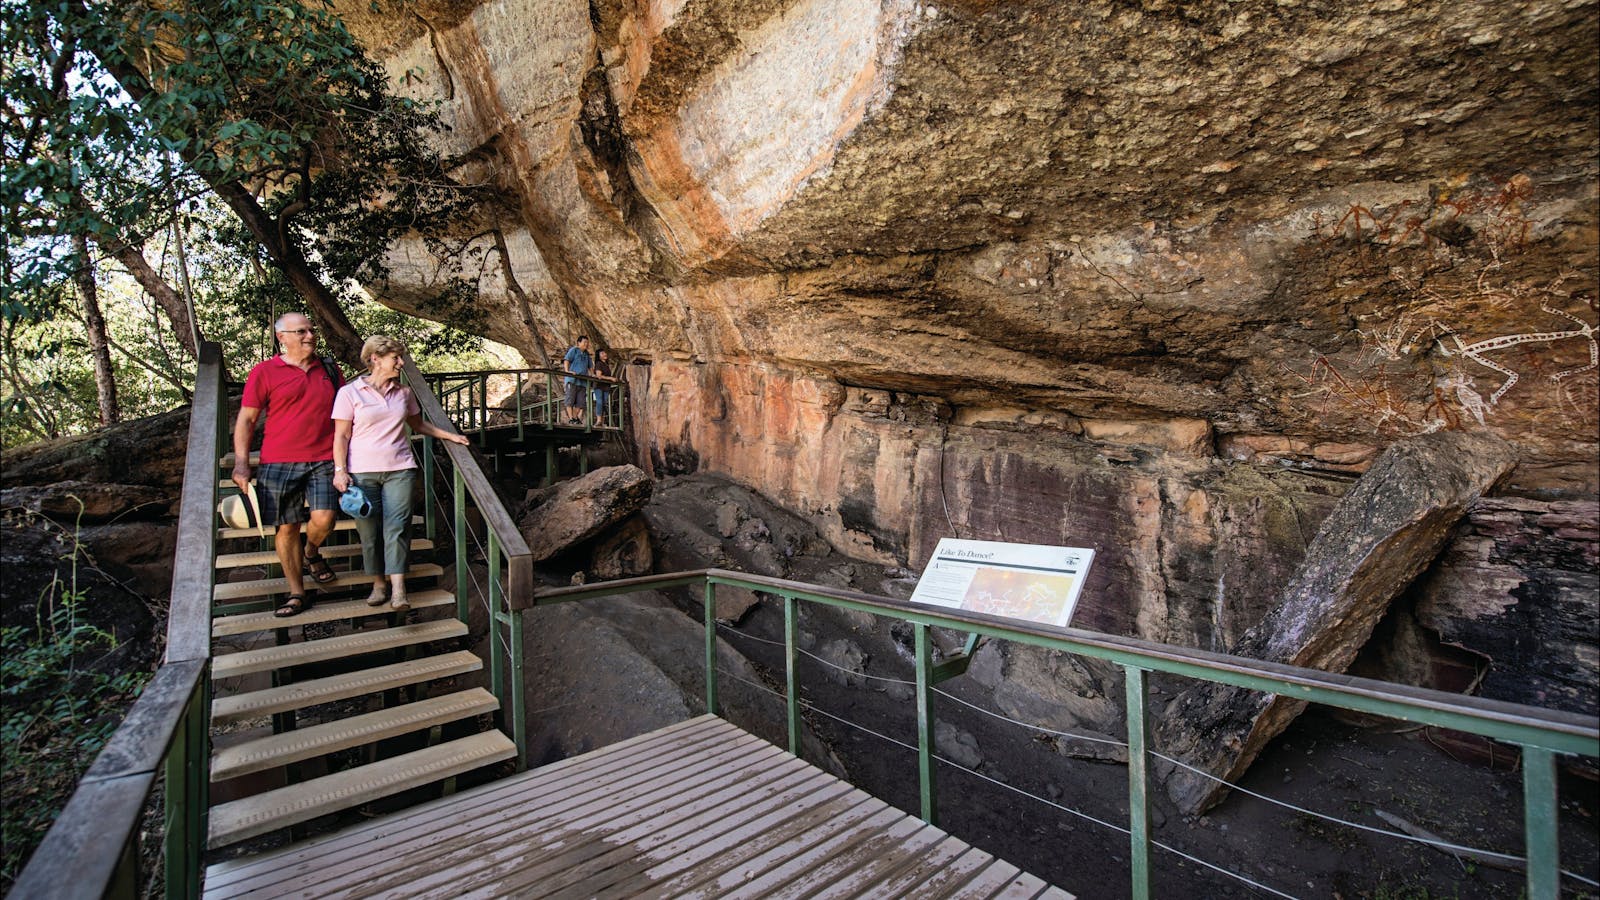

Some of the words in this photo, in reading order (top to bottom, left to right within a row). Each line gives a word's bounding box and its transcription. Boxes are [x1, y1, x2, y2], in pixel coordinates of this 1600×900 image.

[940, 548, 956, 556] Like
[957, 549, 966, 557] To
[966, 550, 995, 560] Dance?
